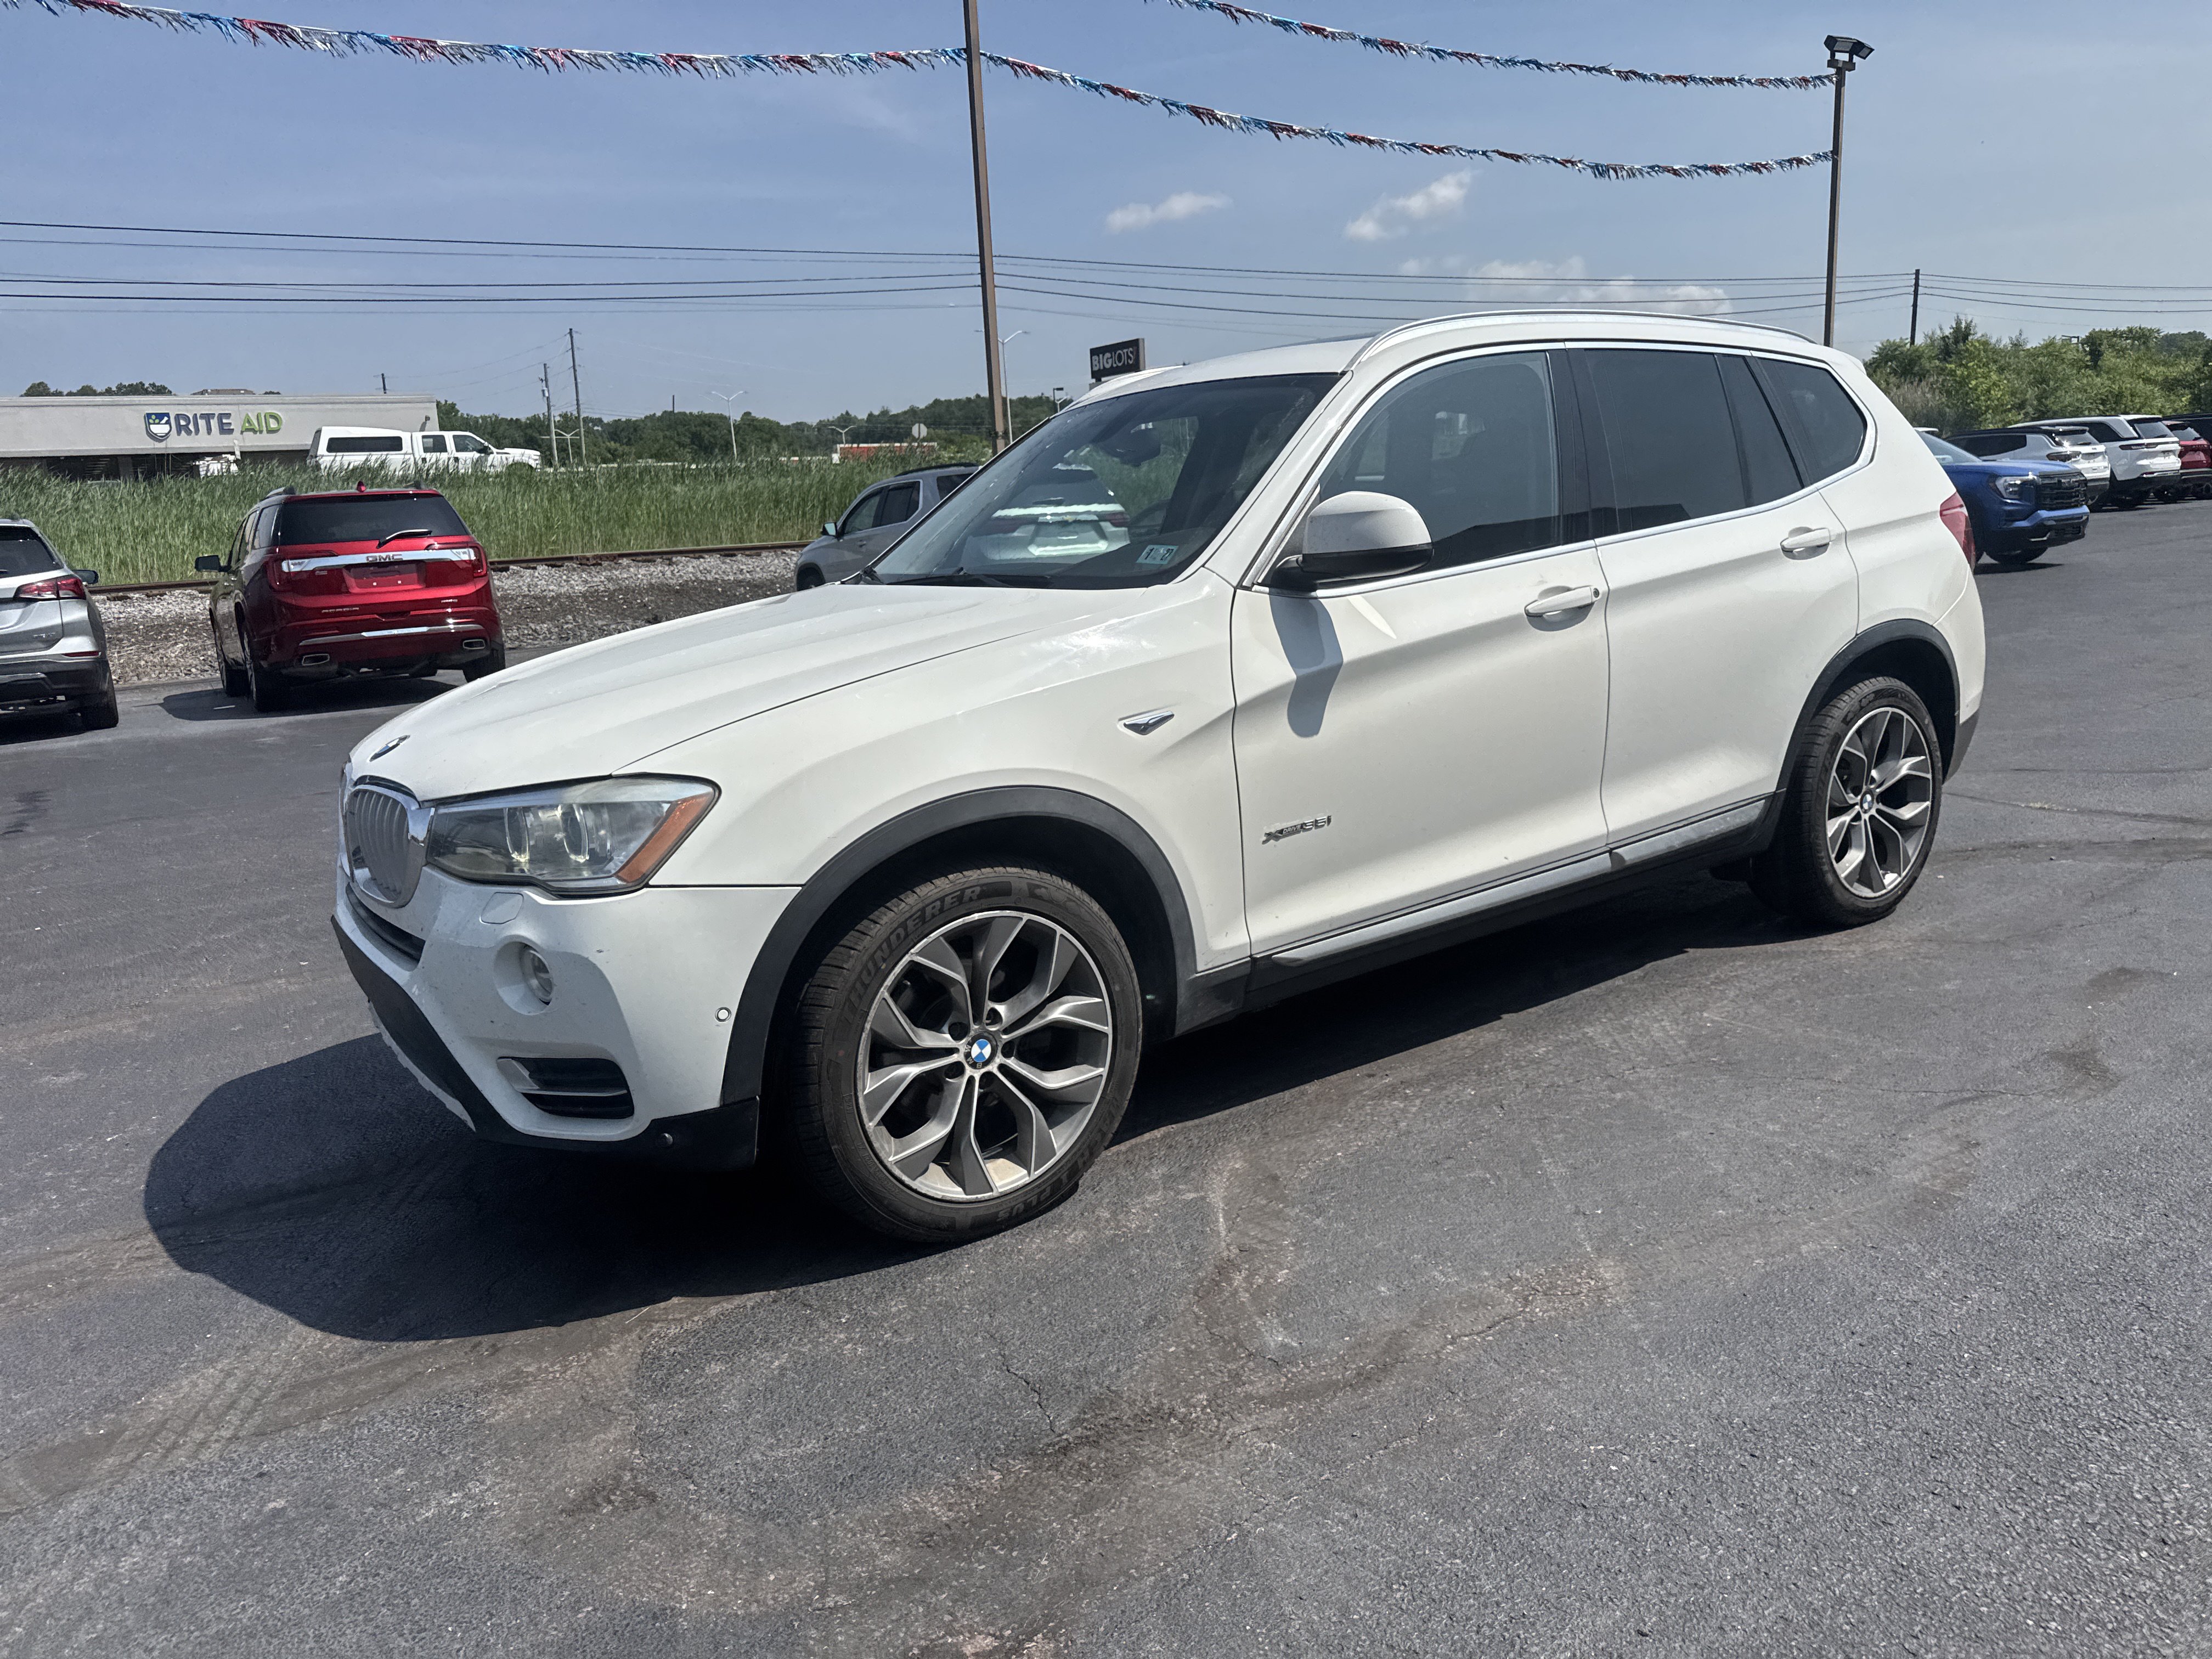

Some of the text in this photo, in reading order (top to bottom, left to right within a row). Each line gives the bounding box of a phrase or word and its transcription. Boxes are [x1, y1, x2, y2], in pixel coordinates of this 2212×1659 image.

[174, 412, 283, 436] RITE AID
[366, 554, 403, 562] GMC
[965, 1045, 983, 1069] BMW
